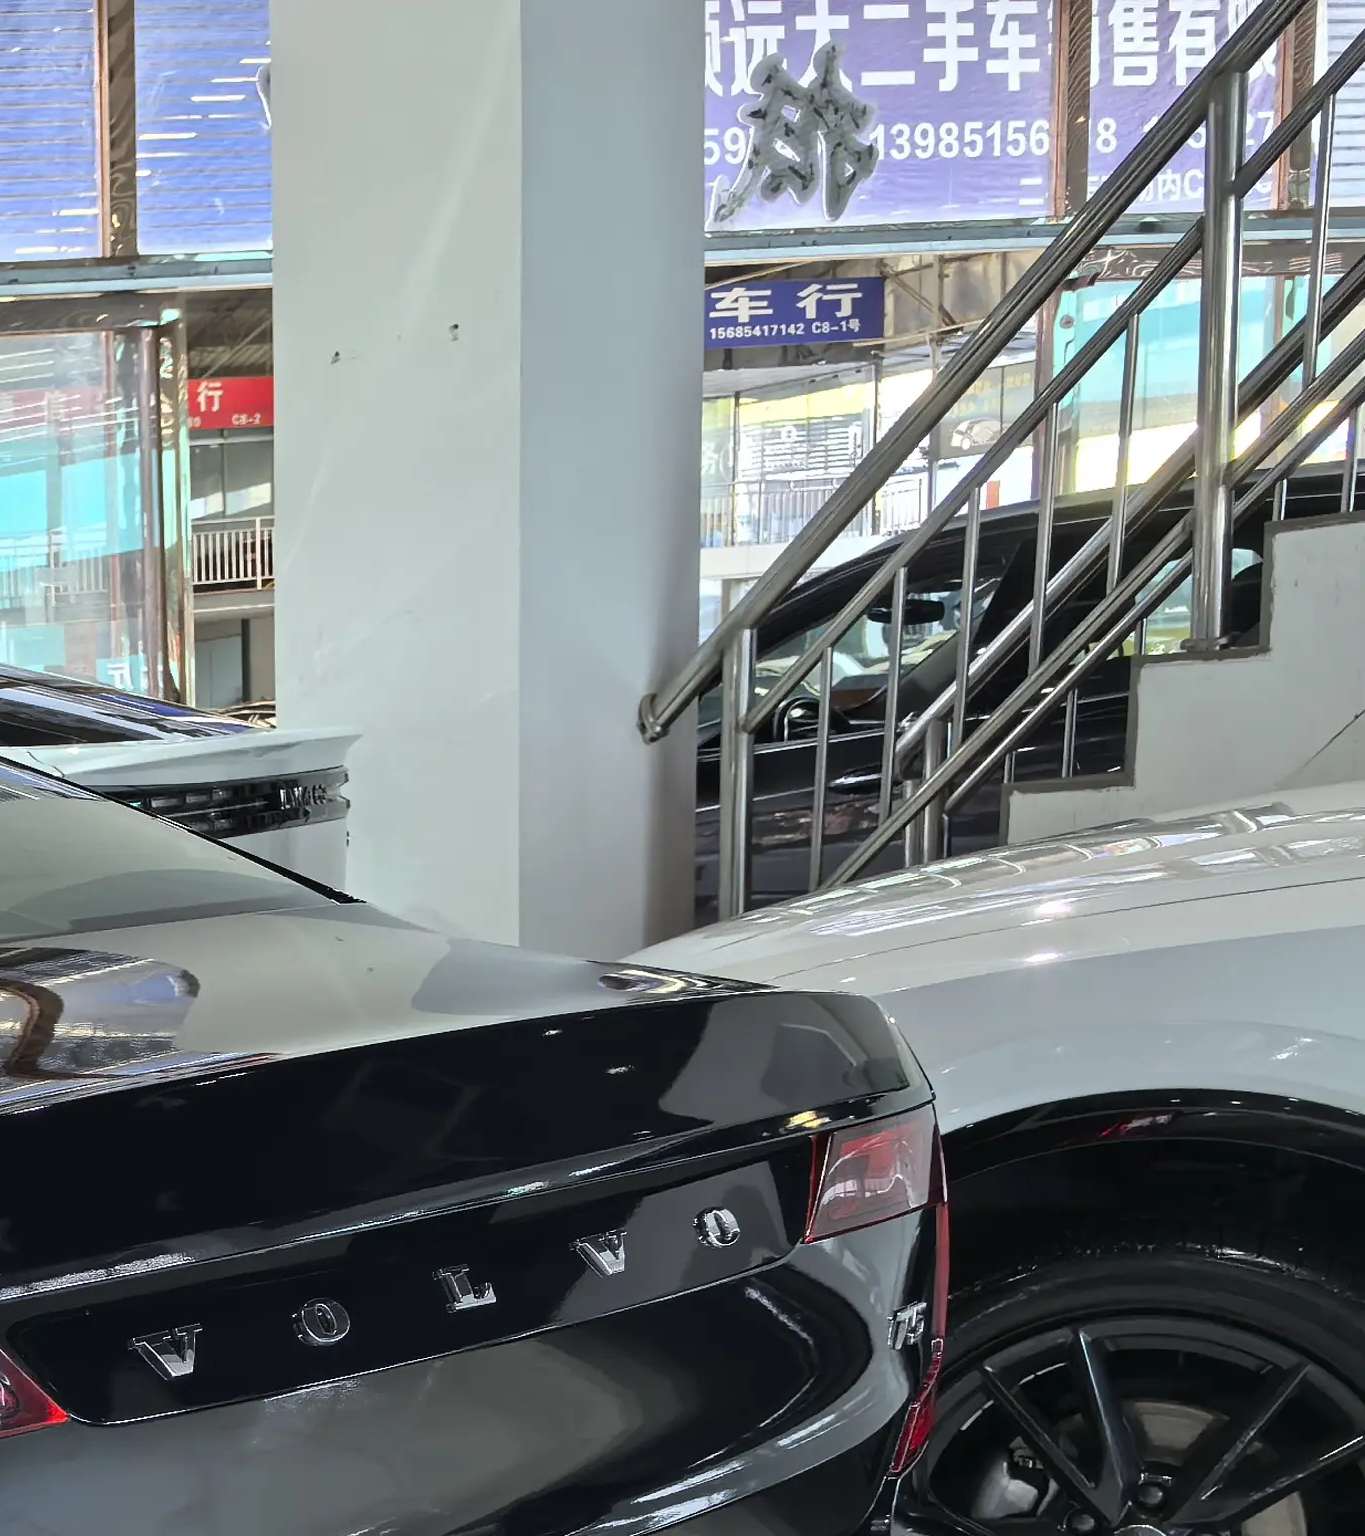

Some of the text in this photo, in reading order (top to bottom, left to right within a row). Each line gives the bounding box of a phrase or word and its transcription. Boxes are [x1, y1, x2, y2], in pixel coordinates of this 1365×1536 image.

[871, 113, 1117, 161] 139851568
[709, 282, 863, 323] 车行
[709, 323, 805, 340] 15685417142
[127, 1205, 743, 1382] VOLVO
